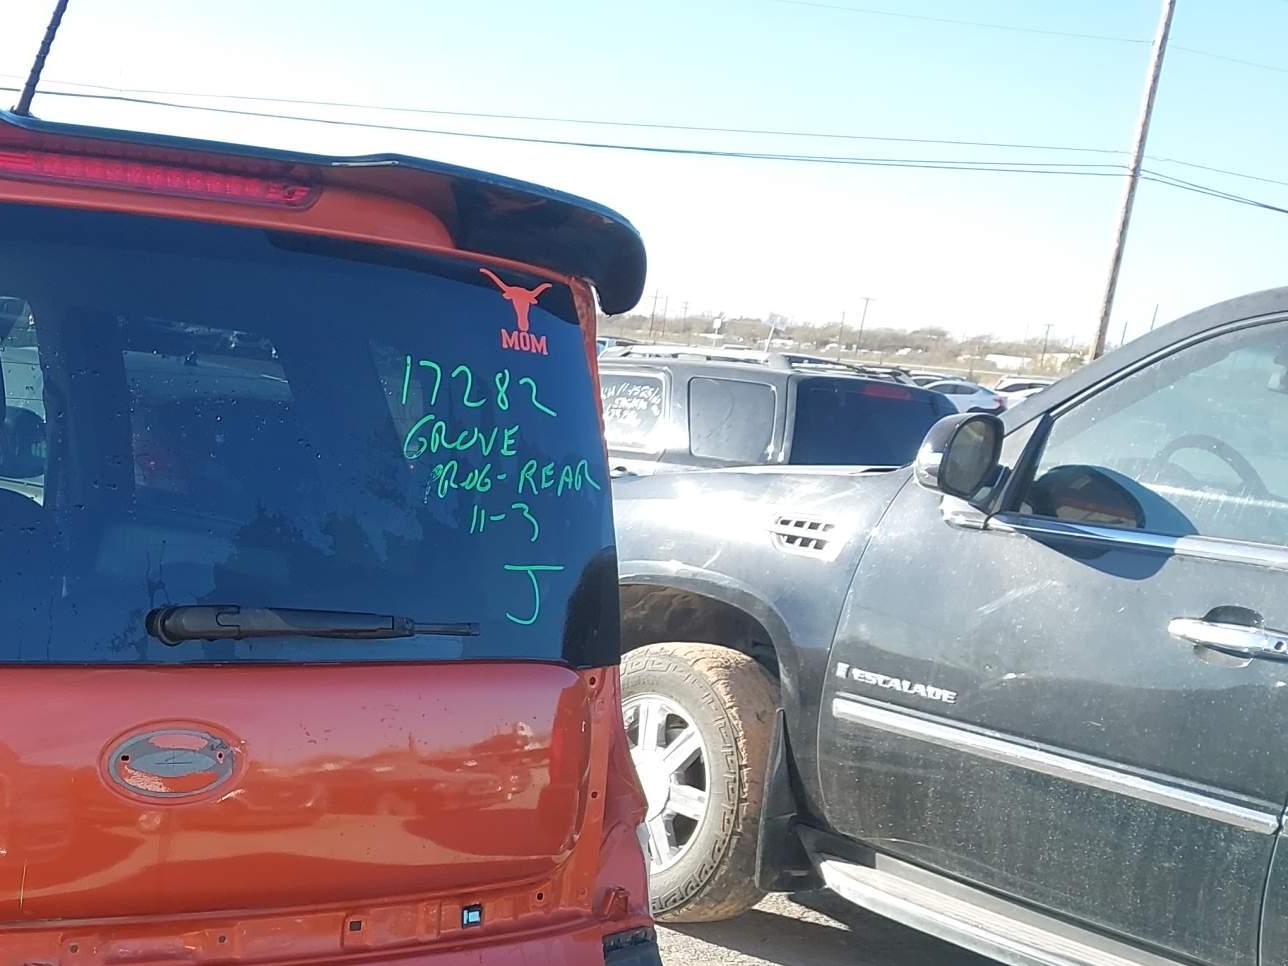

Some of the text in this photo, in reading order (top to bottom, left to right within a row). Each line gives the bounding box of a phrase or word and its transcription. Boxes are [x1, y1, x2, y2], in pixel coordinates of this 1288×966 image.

[500, 328, 549, 356] MOM
[401, 354, 558, 418] 17282
[403, 414, 521, 460] GROVE
[504, 563, 565, 626] J
[850, 667, 958, 704] ESCALADE
